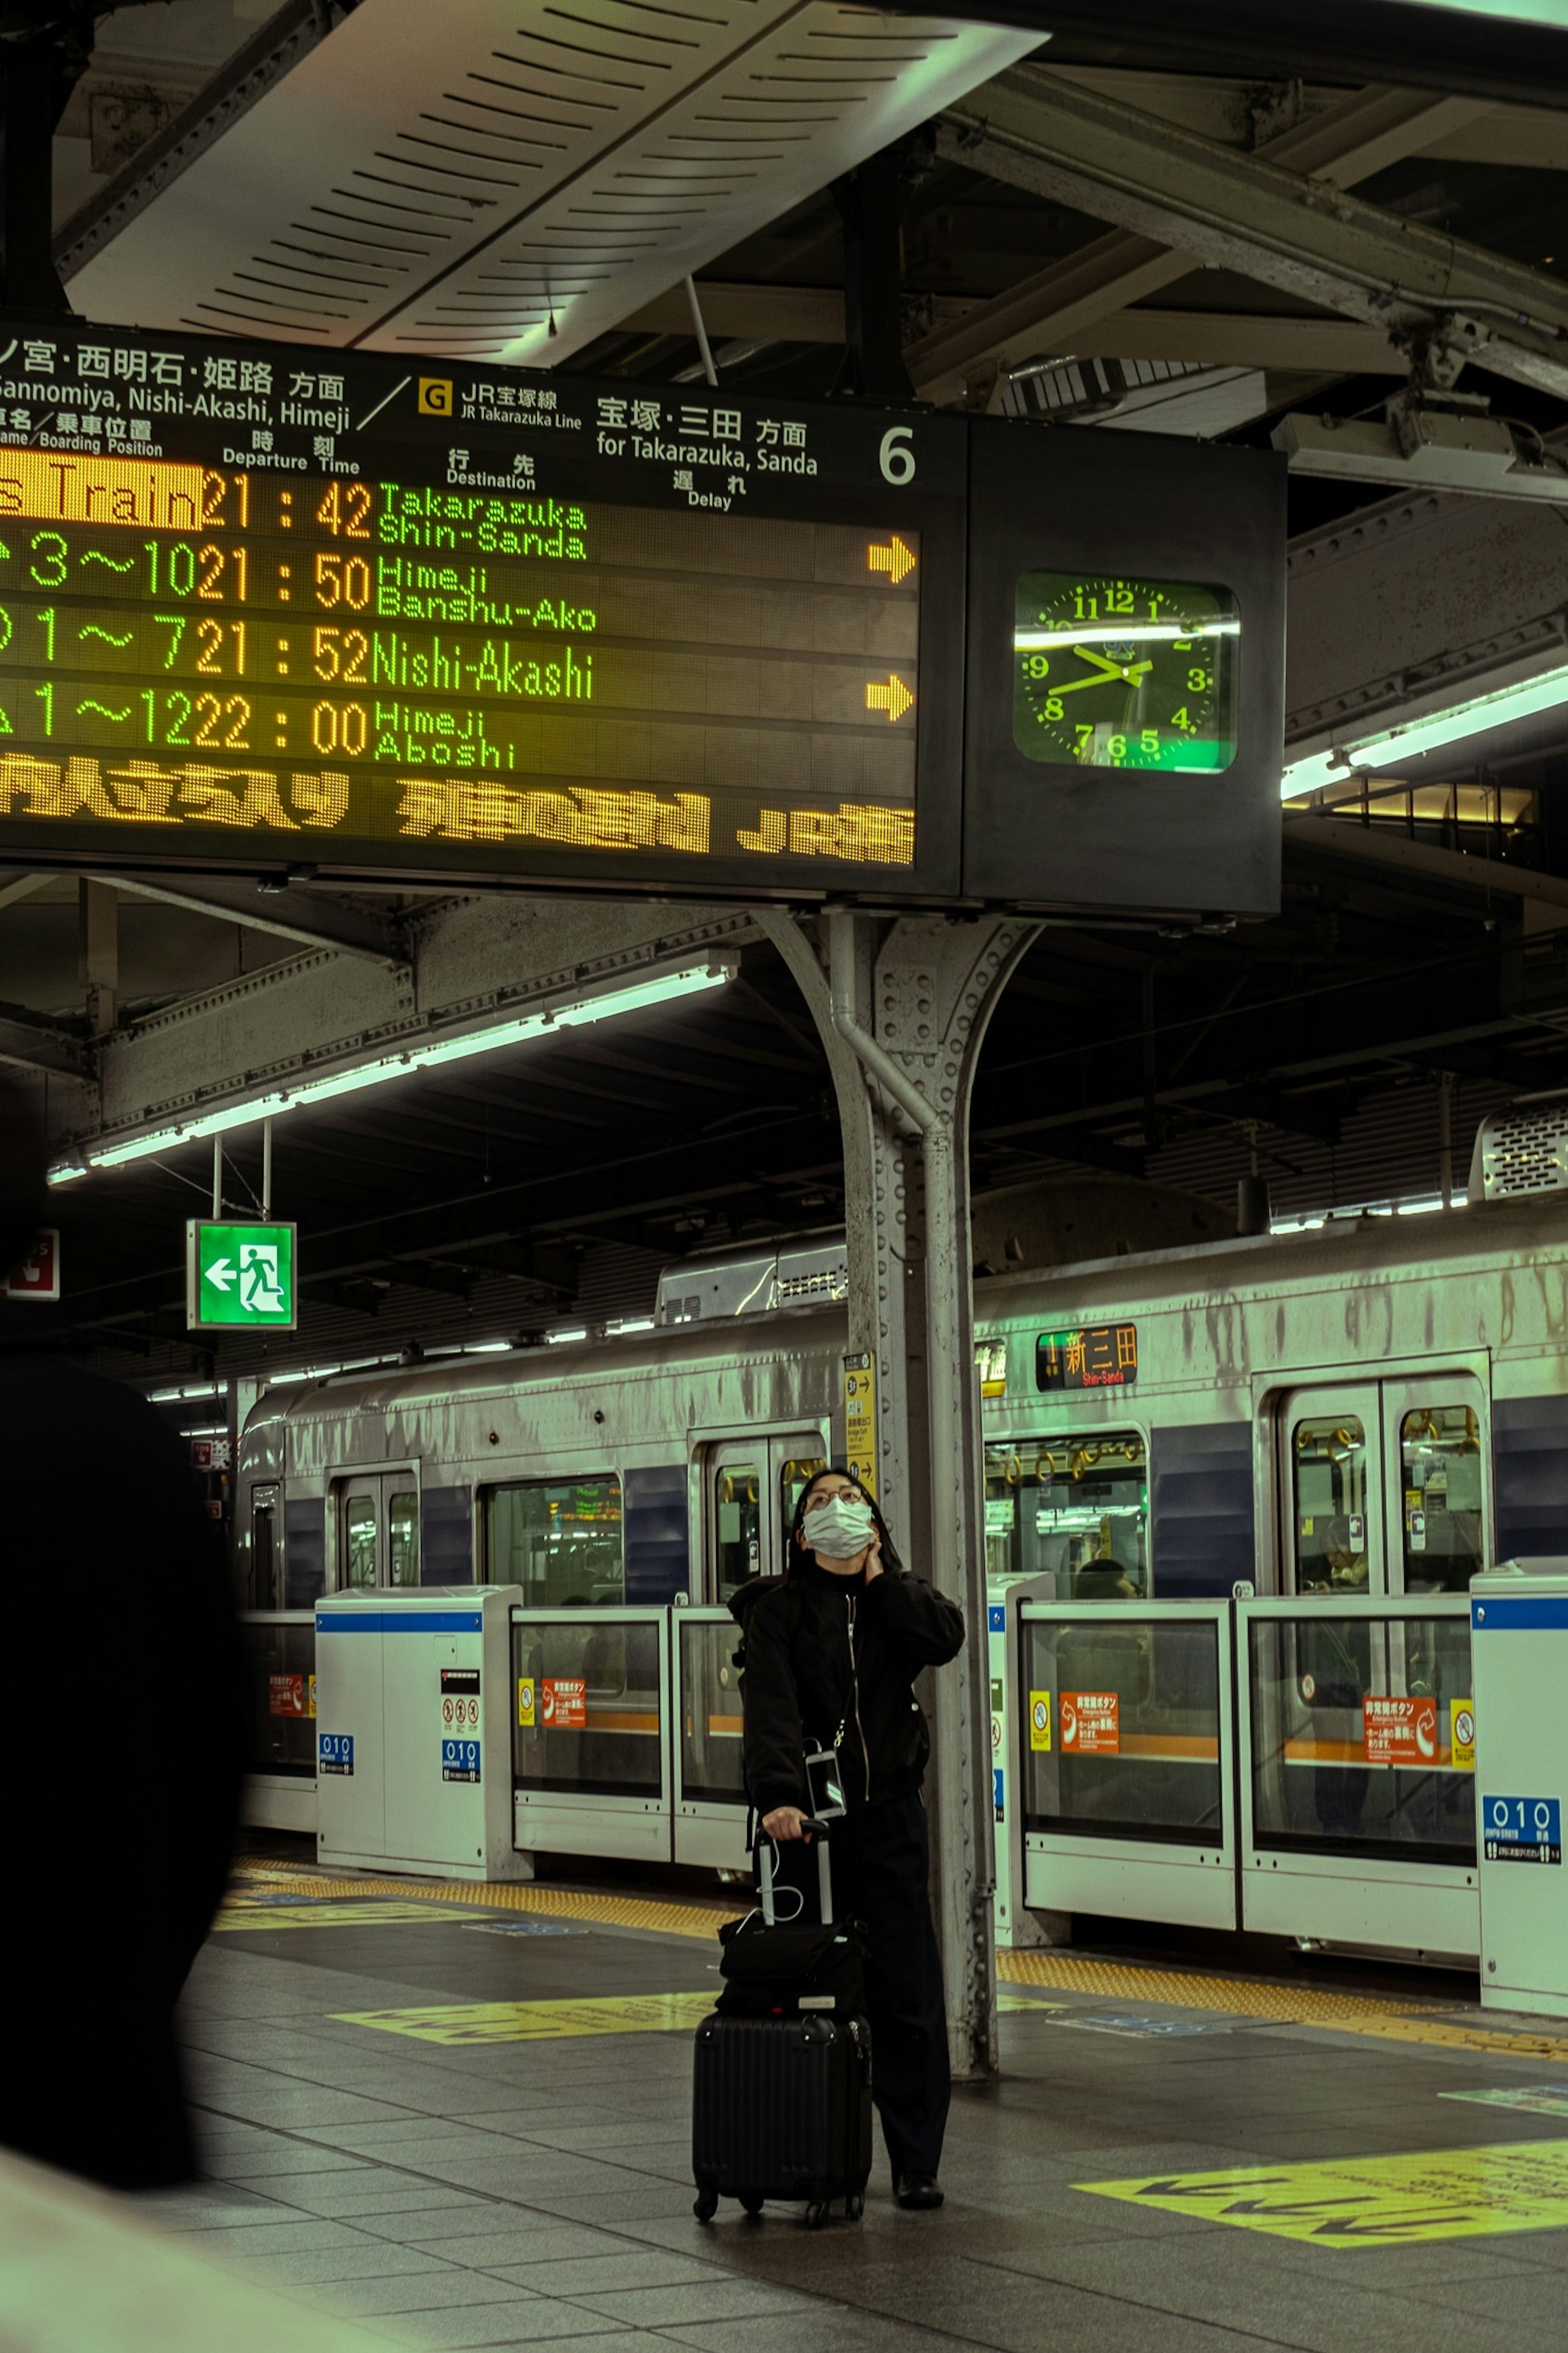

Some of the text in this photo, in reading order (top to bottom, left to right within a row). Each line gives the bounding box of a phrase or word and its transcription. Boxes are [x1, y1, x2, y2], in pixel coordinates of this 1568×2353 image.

[289, 372, 345, 402] 方面
[425, 385, 446, 410] G
[461, 383, 557, 410] JR宝塚線
[0, 375, 350, 435] annomiya, Nishi-Akashi, Himeji
[461, 405, 582, 430] JR Takarazuka Line
[597, 397, 808, 448] 宝塚・三田 方面
[108, 440, 163, 458] Position
[223, 448, 360, 475] Departure Time
[597, 433, 818, 476] for Takarazuka, Sanda
[879, 427, 916, 486] 6
[447, 468, 536, 491] Destination
[50, 463, 196, 524] Train
[688, 491, 731, 512] Delay
[380, 483, 587, 531] Takarazuka
[379, 514, 587, 560] Shin-Sanda
[378, 556, 486, 595] Himeji
[378, 586, 597, 632] Banshu-Ako
[1074, 596, 1099, 620] 11
[1105, 589, 1134, 613] 12
[1148, 601, 1158, 622] 1
[373, 632, 592, 699] Nishi-Akashi
[1029, 655, 1049, 679] 9
[1187, 668, 1206, 692] 3
[376, 702, 483, 740] Himeji
[1043, 697, 1064, 721] 8
[1171, 707, 1191, 730] 4
[1075, 724, 1093, 748] 7
[1107, 734, 1127, 758] 6
[1140, 729, 1160, 753] 5
[375, 733, 514, 769] Aboshi
[1066, 1327, 1137, 1374] 新三田
[1083, 1369, 1125, 1387] Shin-Sanda
